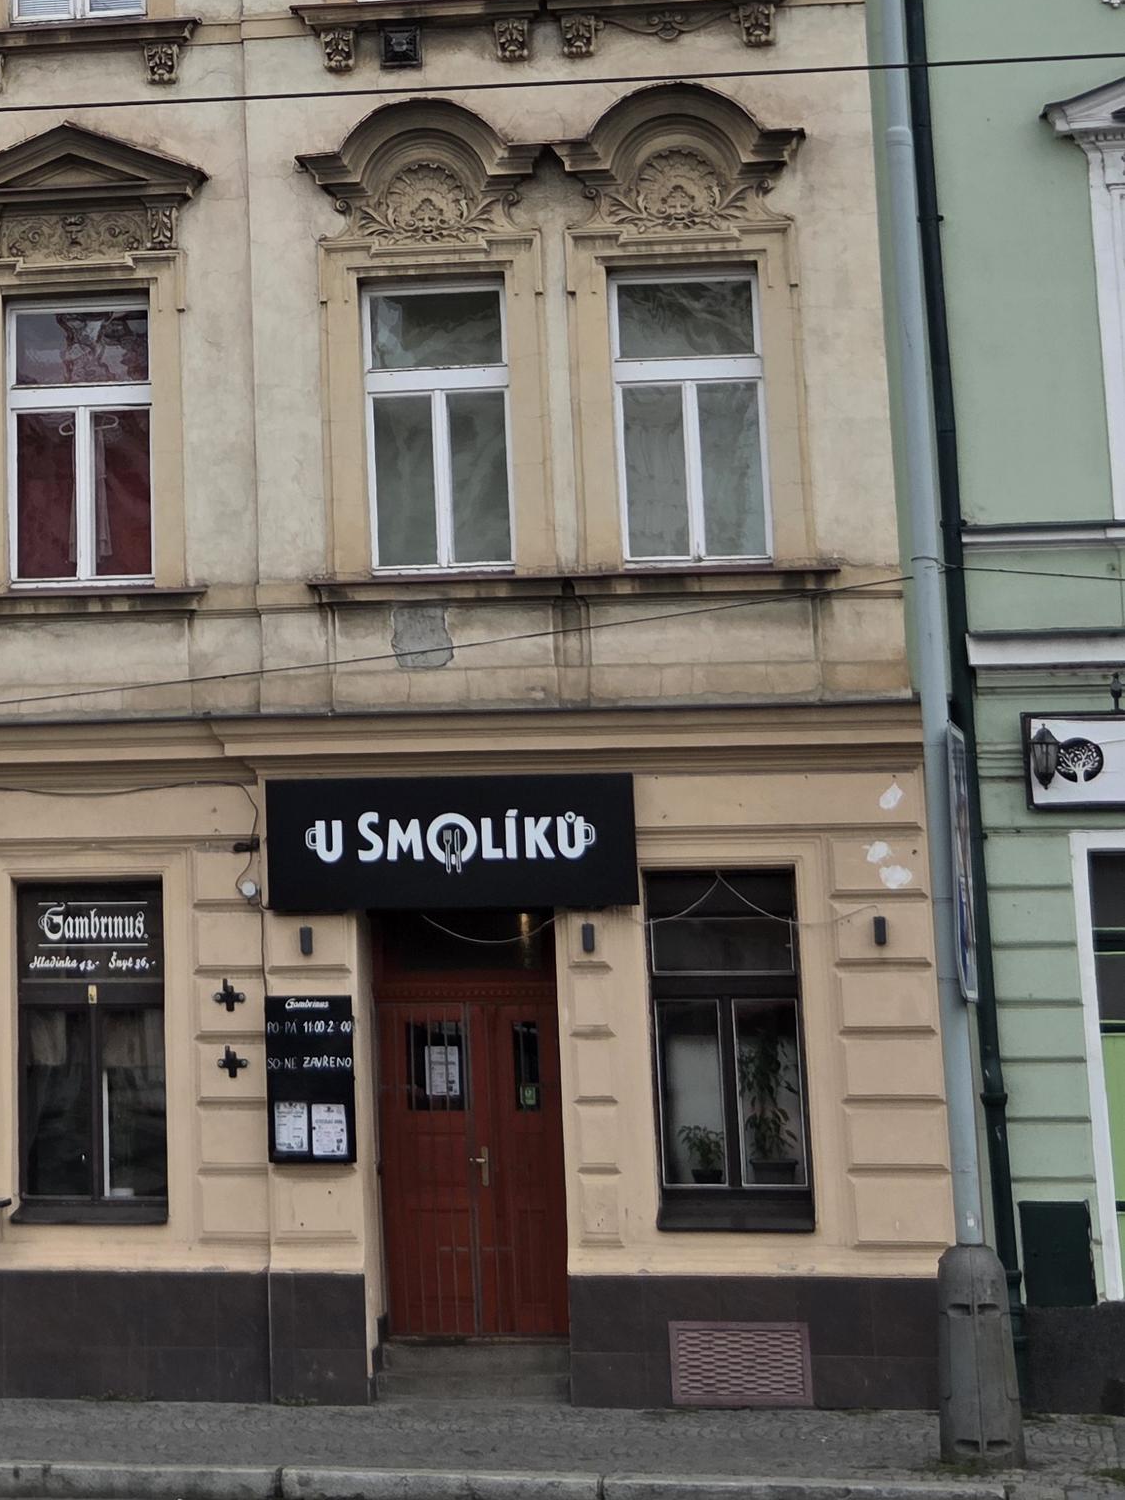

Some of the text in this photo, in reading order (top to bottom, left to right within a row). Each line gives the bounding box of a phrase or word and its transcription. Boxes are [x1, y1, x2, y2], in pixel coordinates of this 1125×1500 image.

[313, 808, 587, 873] U SMOLÍKŮ
[37, 902, 145, 940] Gambrinus
[29, 955, 77, 969] Hladinka
[108, 951, 133, 970] Šnyt
[285, 997, 329, 1010] Gambrinus
